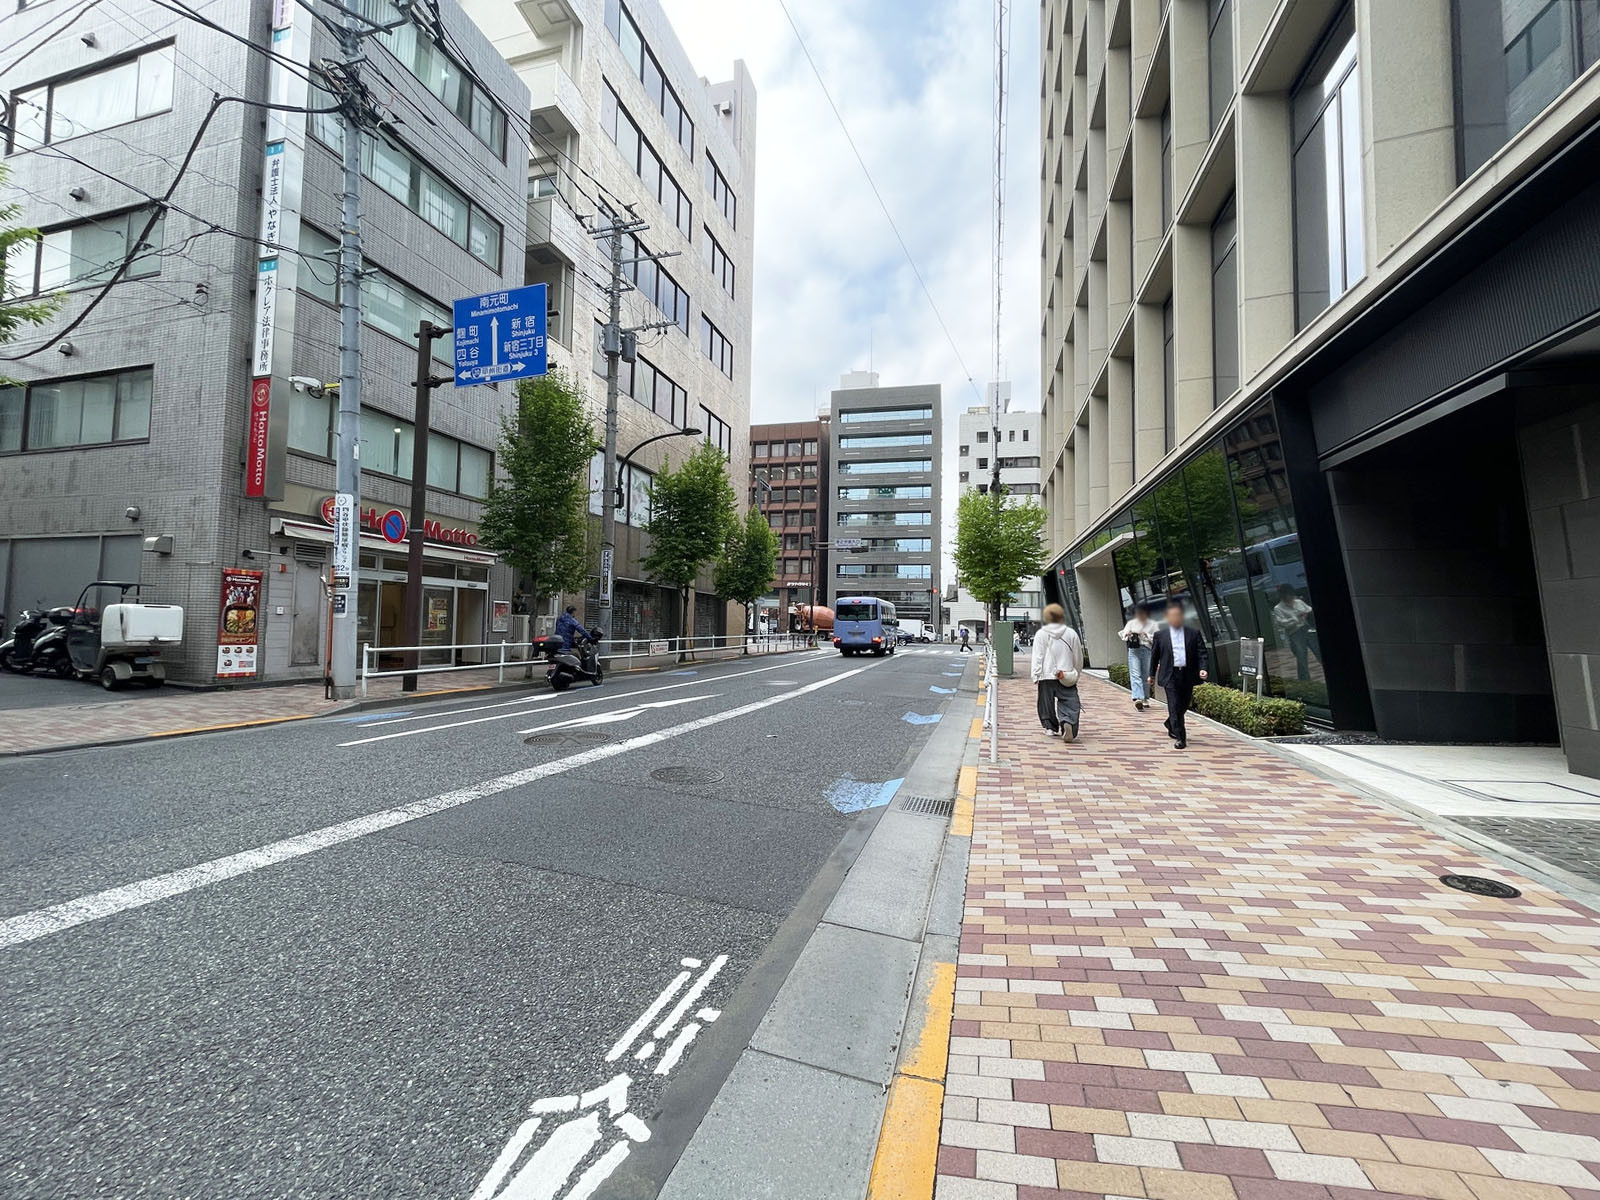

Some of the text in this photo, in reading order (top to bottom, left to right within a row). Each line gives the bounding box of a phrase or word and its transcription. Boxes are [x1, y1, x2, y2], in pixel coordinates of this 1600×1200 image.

[480, 293, 509, 308] 南元町
[471, 303, 518, 317] Minamimotomachi
[260, 275, 273, 371] ホクレア法律事務所
[512, 316, 535, 329] 新宿
[512, 329, 535, 337] Shinjuku
[457, 338, 479, 347] Kojimachi
[504, 336, 543, 352] 新宿三丁目
[457, 347, 479, 360] 四谷
[509, 351, 532, 360] Shinjuku
[255, 410, 267, 486] HottoMotto
